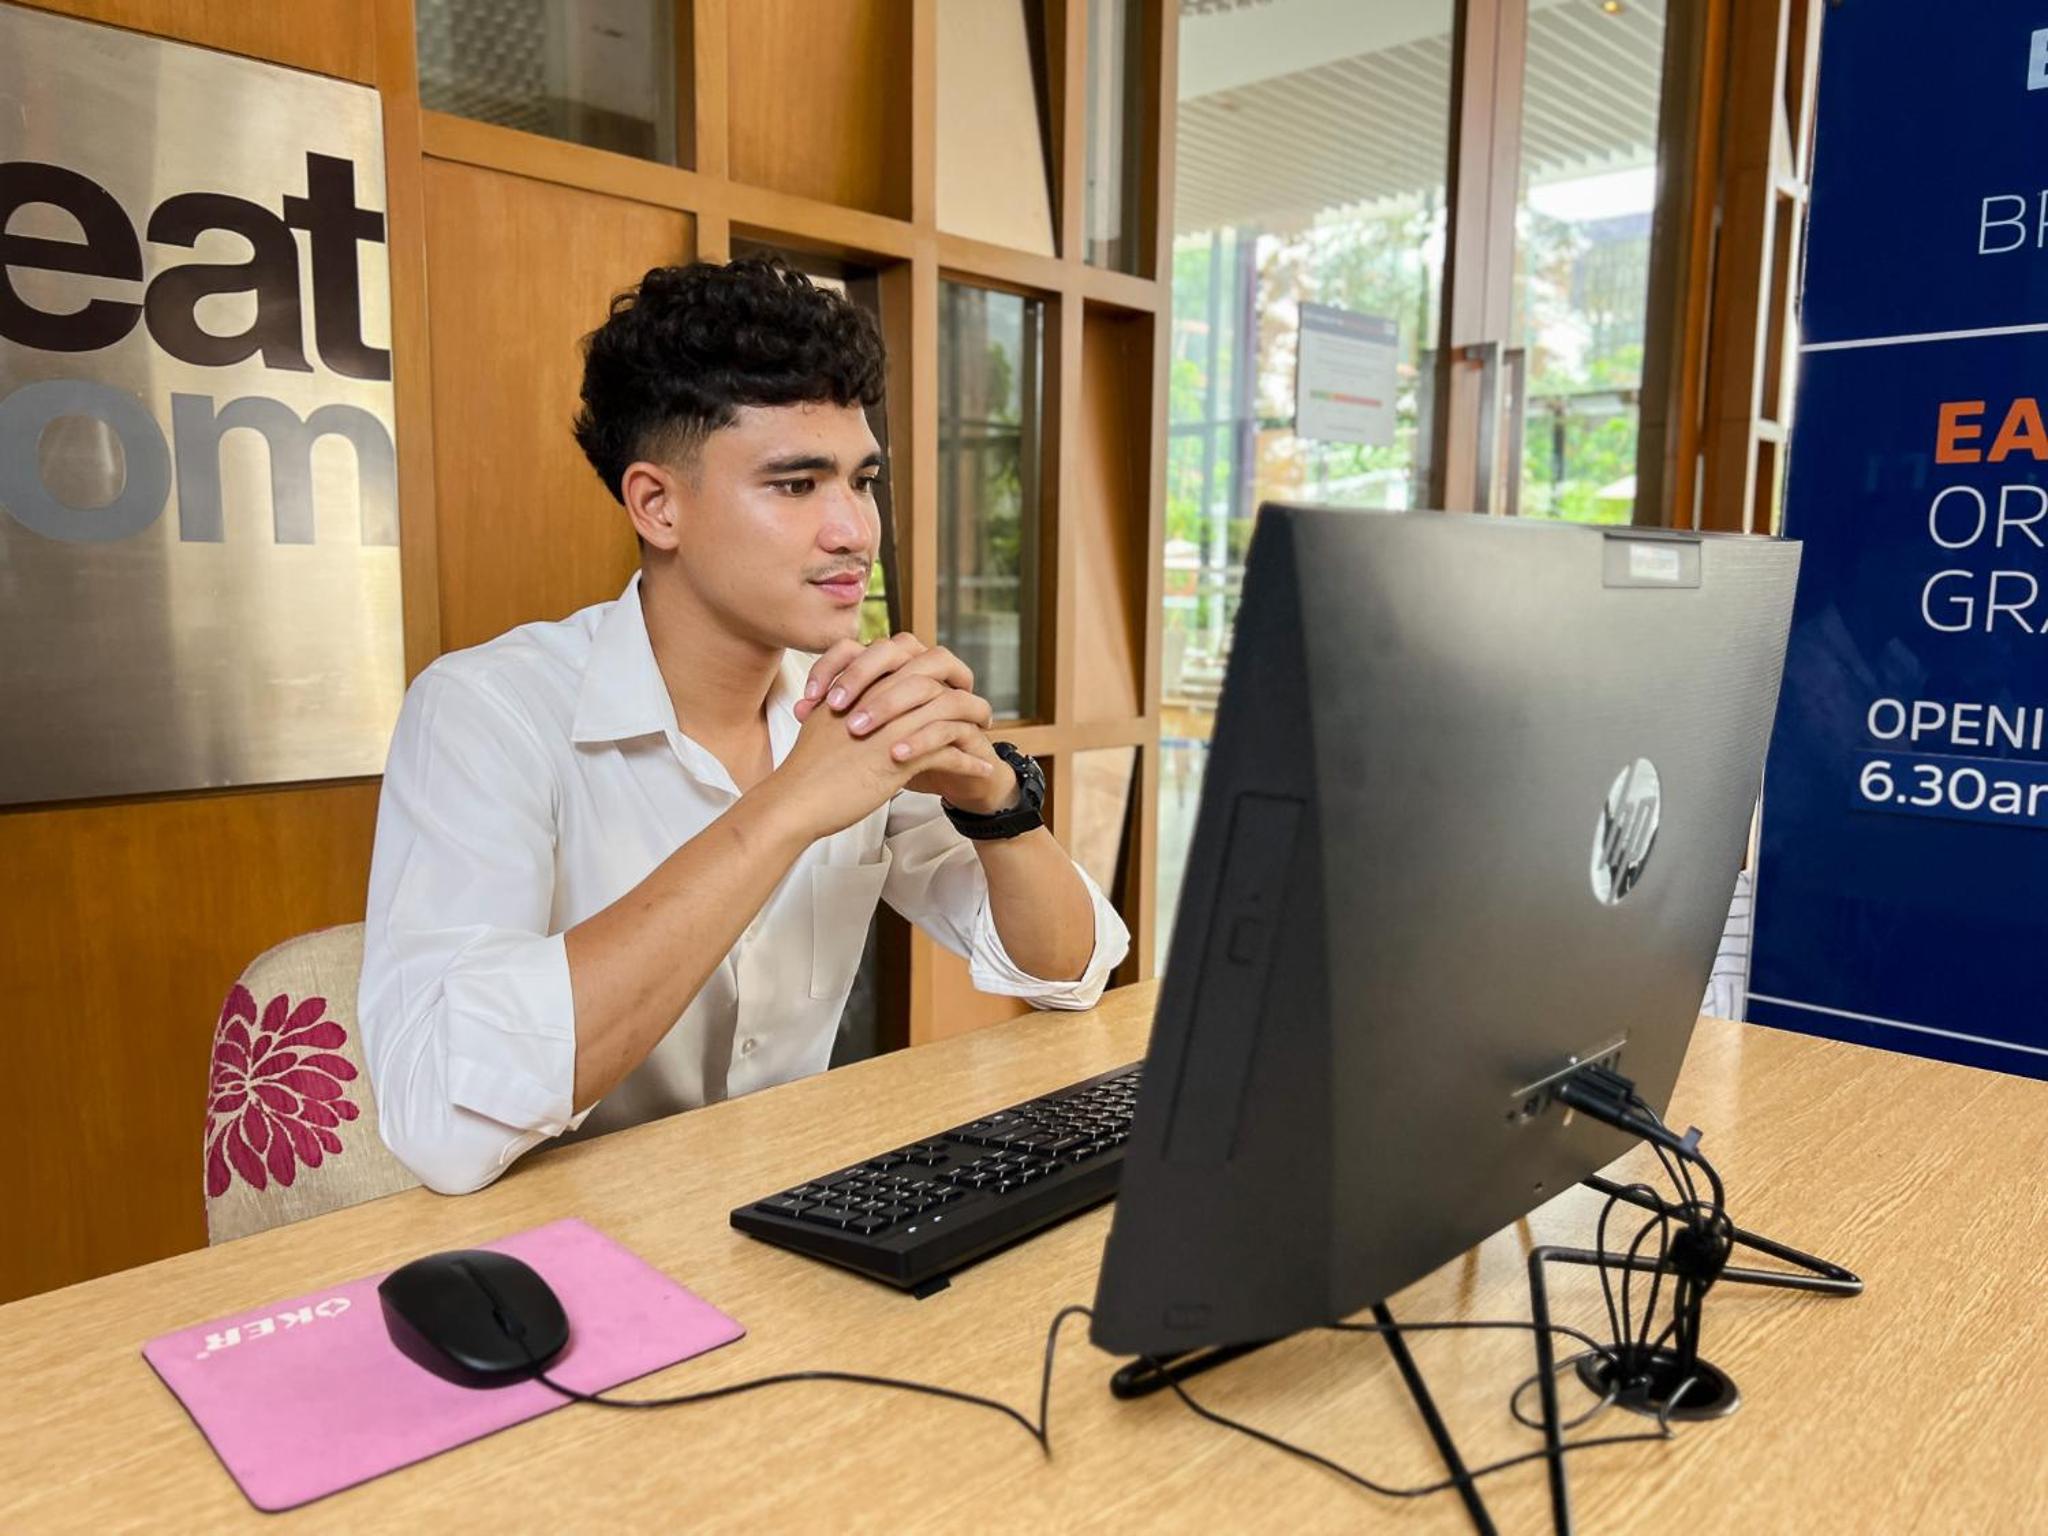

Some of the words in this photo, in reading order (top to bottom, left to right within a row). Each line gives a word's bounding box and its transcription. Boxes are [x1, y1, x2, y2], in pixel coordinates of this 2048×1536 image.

[1979, 190, 2048, 254] B
[0, 151, 391, 381] eat
[0, 379, 399, 546] om
[1935, 398, 2048, 464] EA
[1929, 485, 2048, 548] OR
[1922, 569, 2048, 634] GR
[1867, 698, 2044, 750] OPENI
